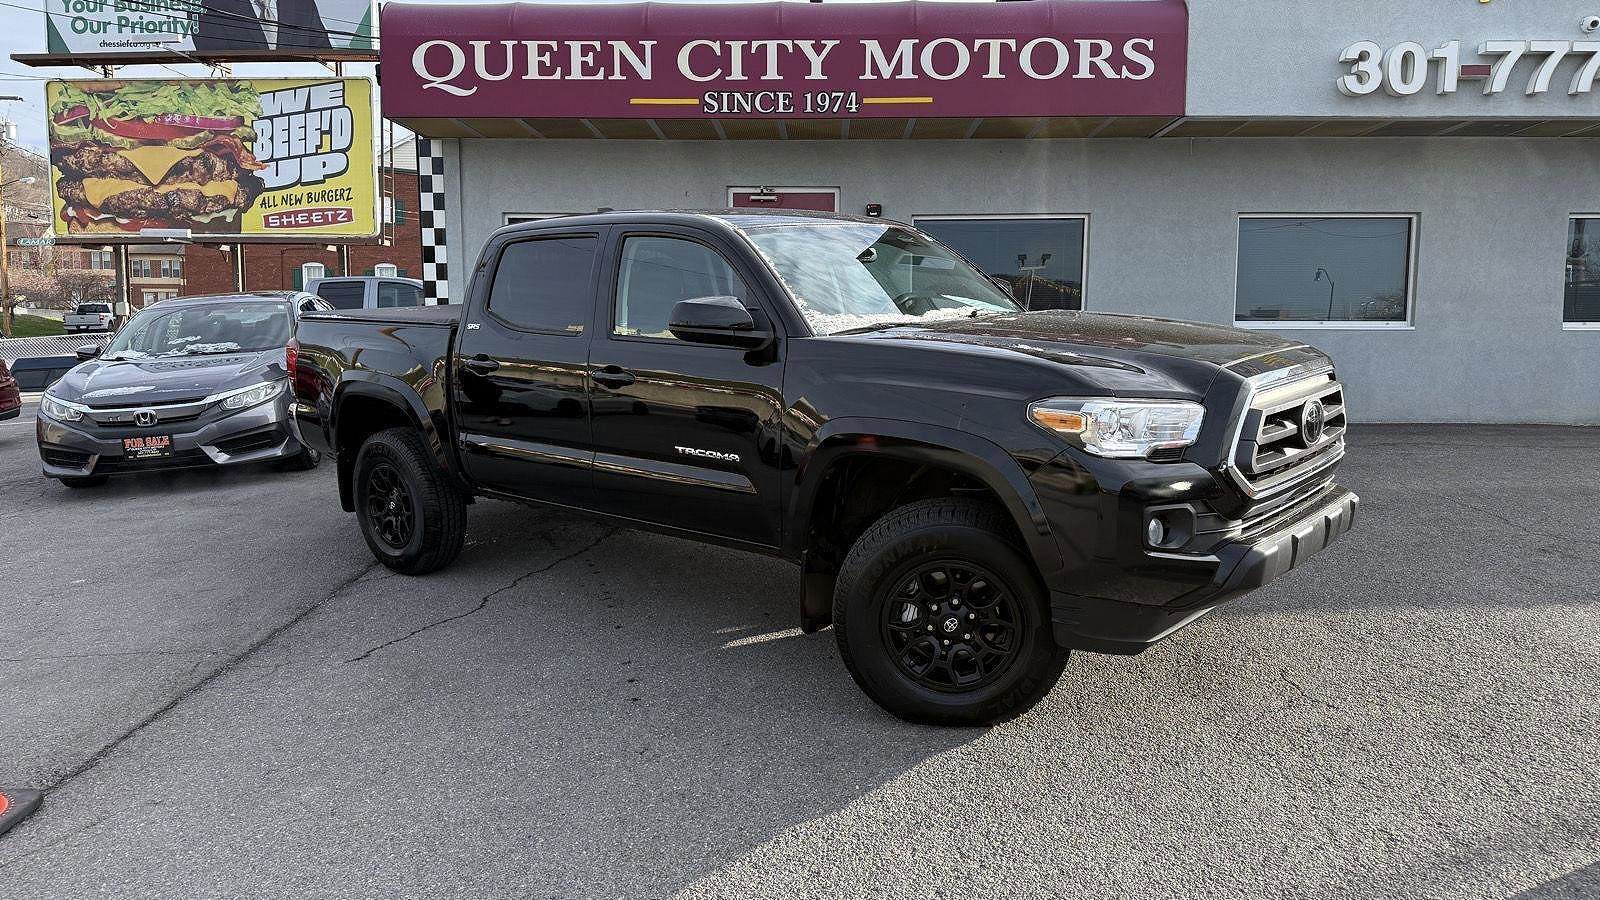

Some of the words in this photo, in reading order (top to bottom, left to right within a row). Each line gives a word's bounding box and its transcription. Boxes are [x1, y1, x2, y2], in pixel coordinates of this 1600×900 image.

[61, 0, 105, 13] Your
[70, 16, 111, 35] Our
[117, 15, 200, 40] Priority!
[411, 39, 658, 97] QUEEN
[676, 39, 840, 83] CITY
[858, 37, 1156, 81] MOTORS
[260, 81, 345, 117] WE
[703, 91, 794, 114] SINCE
[802, 91, 860, 114] 1974
[252, 107, 353, 161] BEEF'D
[254, 152, 349, 191] UP
[259, 195, 278, 209] ALL
[281, 192, 304, 207] NEW
[306, 187, 354, 204] BURGERZ
[268, 210, 348, 227] SHEETZ
[20, 238, 54, 246] LAMAR
[146, 435, 170, 447] SALE
[674, 445, 740, 462] TACOMA
